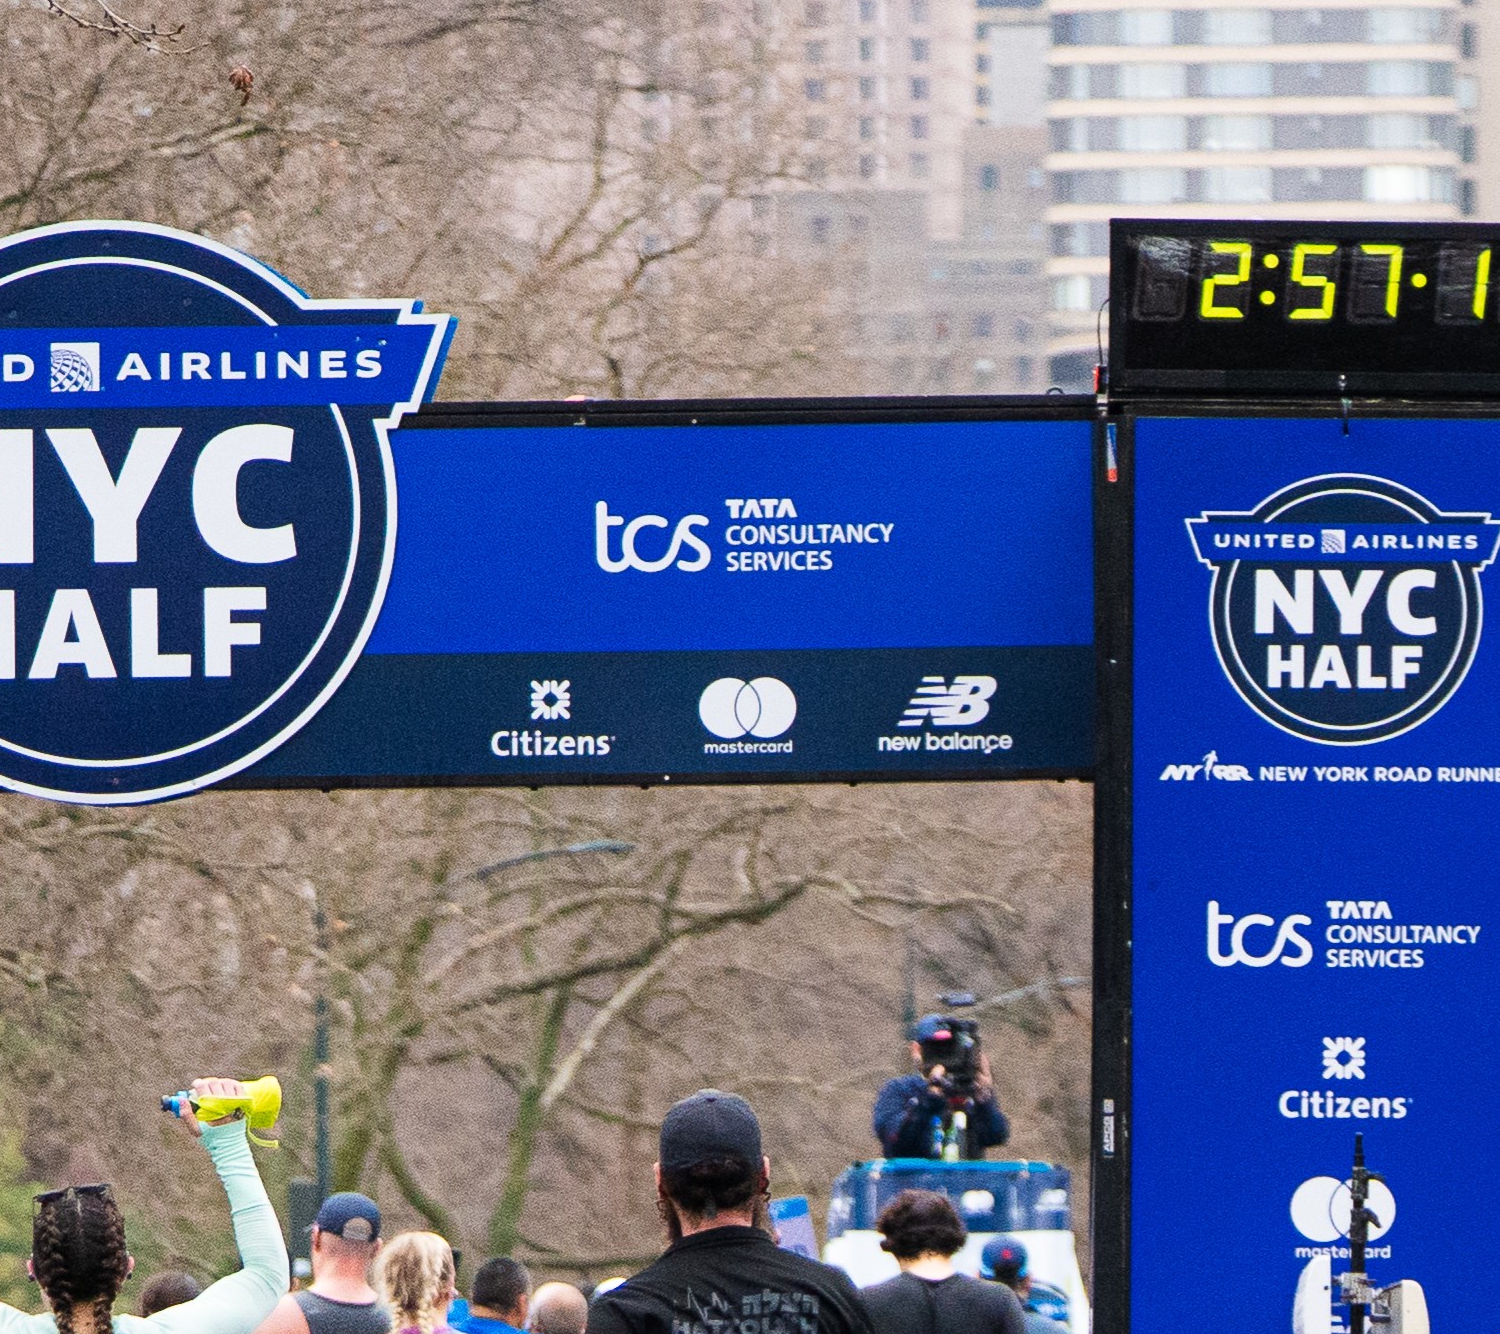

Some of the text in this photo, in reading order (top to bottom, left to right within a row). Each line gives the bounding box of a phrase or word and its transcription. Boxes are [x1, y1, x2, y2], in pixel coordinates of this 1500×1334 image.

[117, 350, 381, 380] AIRLINES
[726, 499, 797, 518] TATA
[596, 501, 711, 572] tcs
[726, 524, 893, 545] CONSULTANCY
[1215, 534, 1477, 549] UNITED AIRLINES
[727, 551, 832, 571] SERVICES
[1255, 569, 1437, 635] NYC
[1268, 645, 1422, 688] HALF
[491, 731, 612, 756] Citizens
[704, 740, 792, 753] mastercard
[879, 732, 1012, 753] new balance
[1159, 757, 1254, 782] NYRR
[1260, 767, 1307, 781] NEW
[1315, 767, 1368, 781] YORK
[1375, 767, 1432, 782] ROAD
[1327, 901, 1392, 919] TATA
[1208, 901, 1313, 967] tcs
[1326, 925, 1480, 944] CONSULTANCY
[1327, 949, 1424, 967] SERVICES
[1279, 1091, 1408, 1118] Citizens
[1295, 1245, 1391, 1259] masterard
